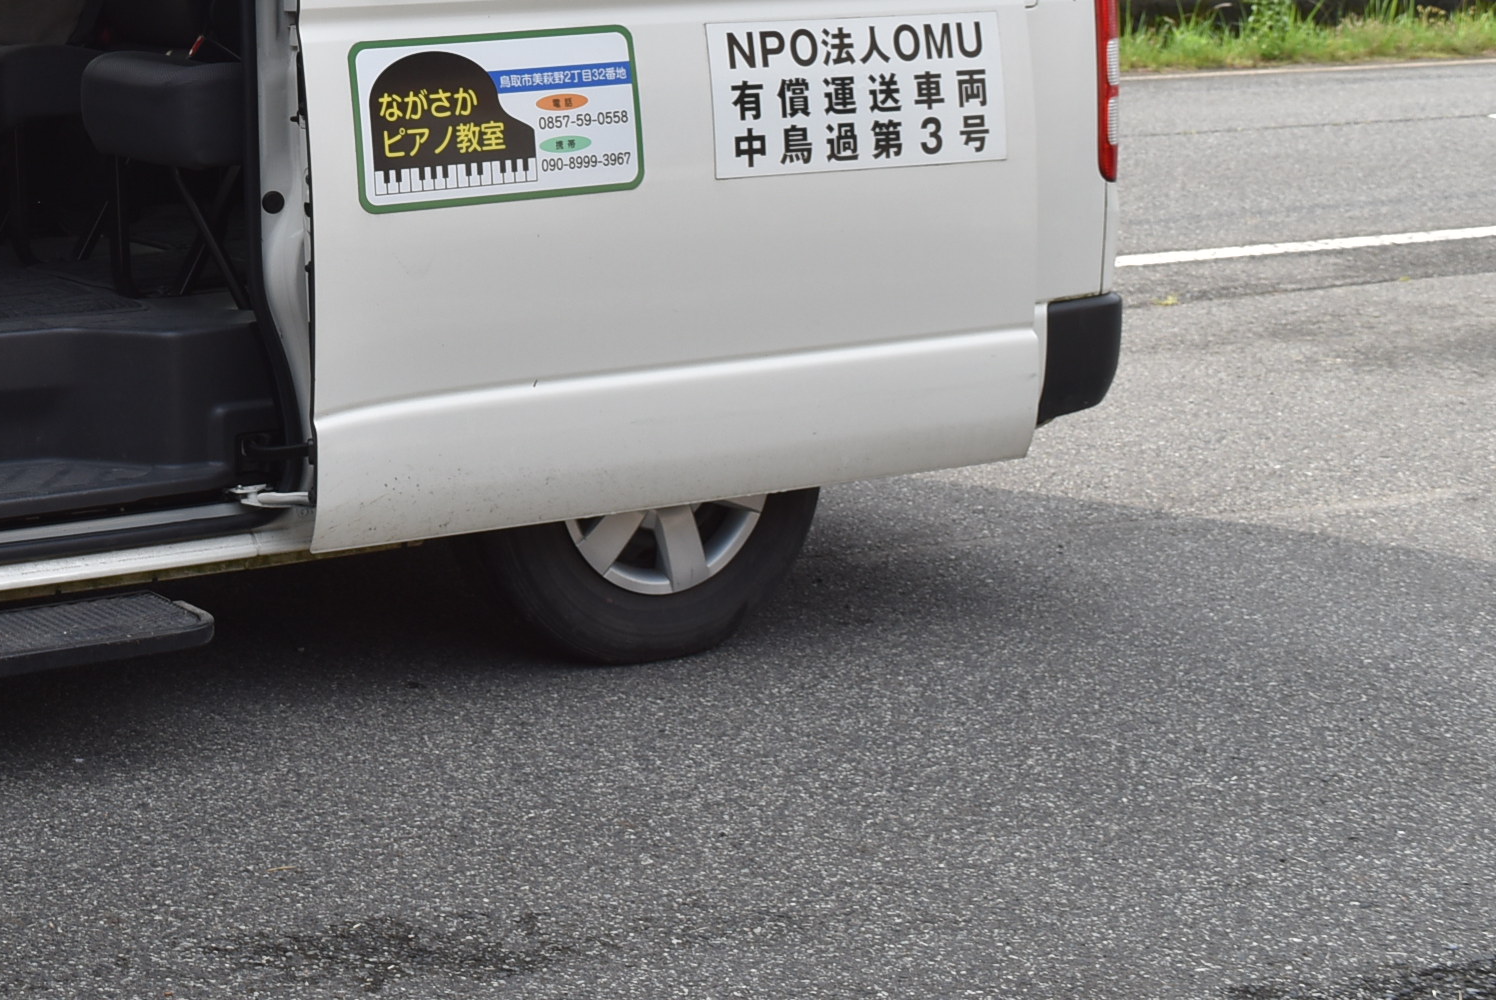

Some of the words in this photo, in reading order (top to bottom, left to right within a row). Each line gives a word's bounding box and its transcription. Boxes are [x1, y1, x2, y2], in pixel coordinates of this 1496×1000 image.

[726, 21, 983, 69] NPO法人OMU
[378, 87, 478, 122] ながさか
[730, 69, 988, 121] 有償運送車両
[383, 120, 506, 158] ピアノ教室
[538, 110, 629, 130] 0857-59-0558
[734, 114, 990, 168] 中鳥過第3号
[541, 152, 631, 172] 090-8999-3967
